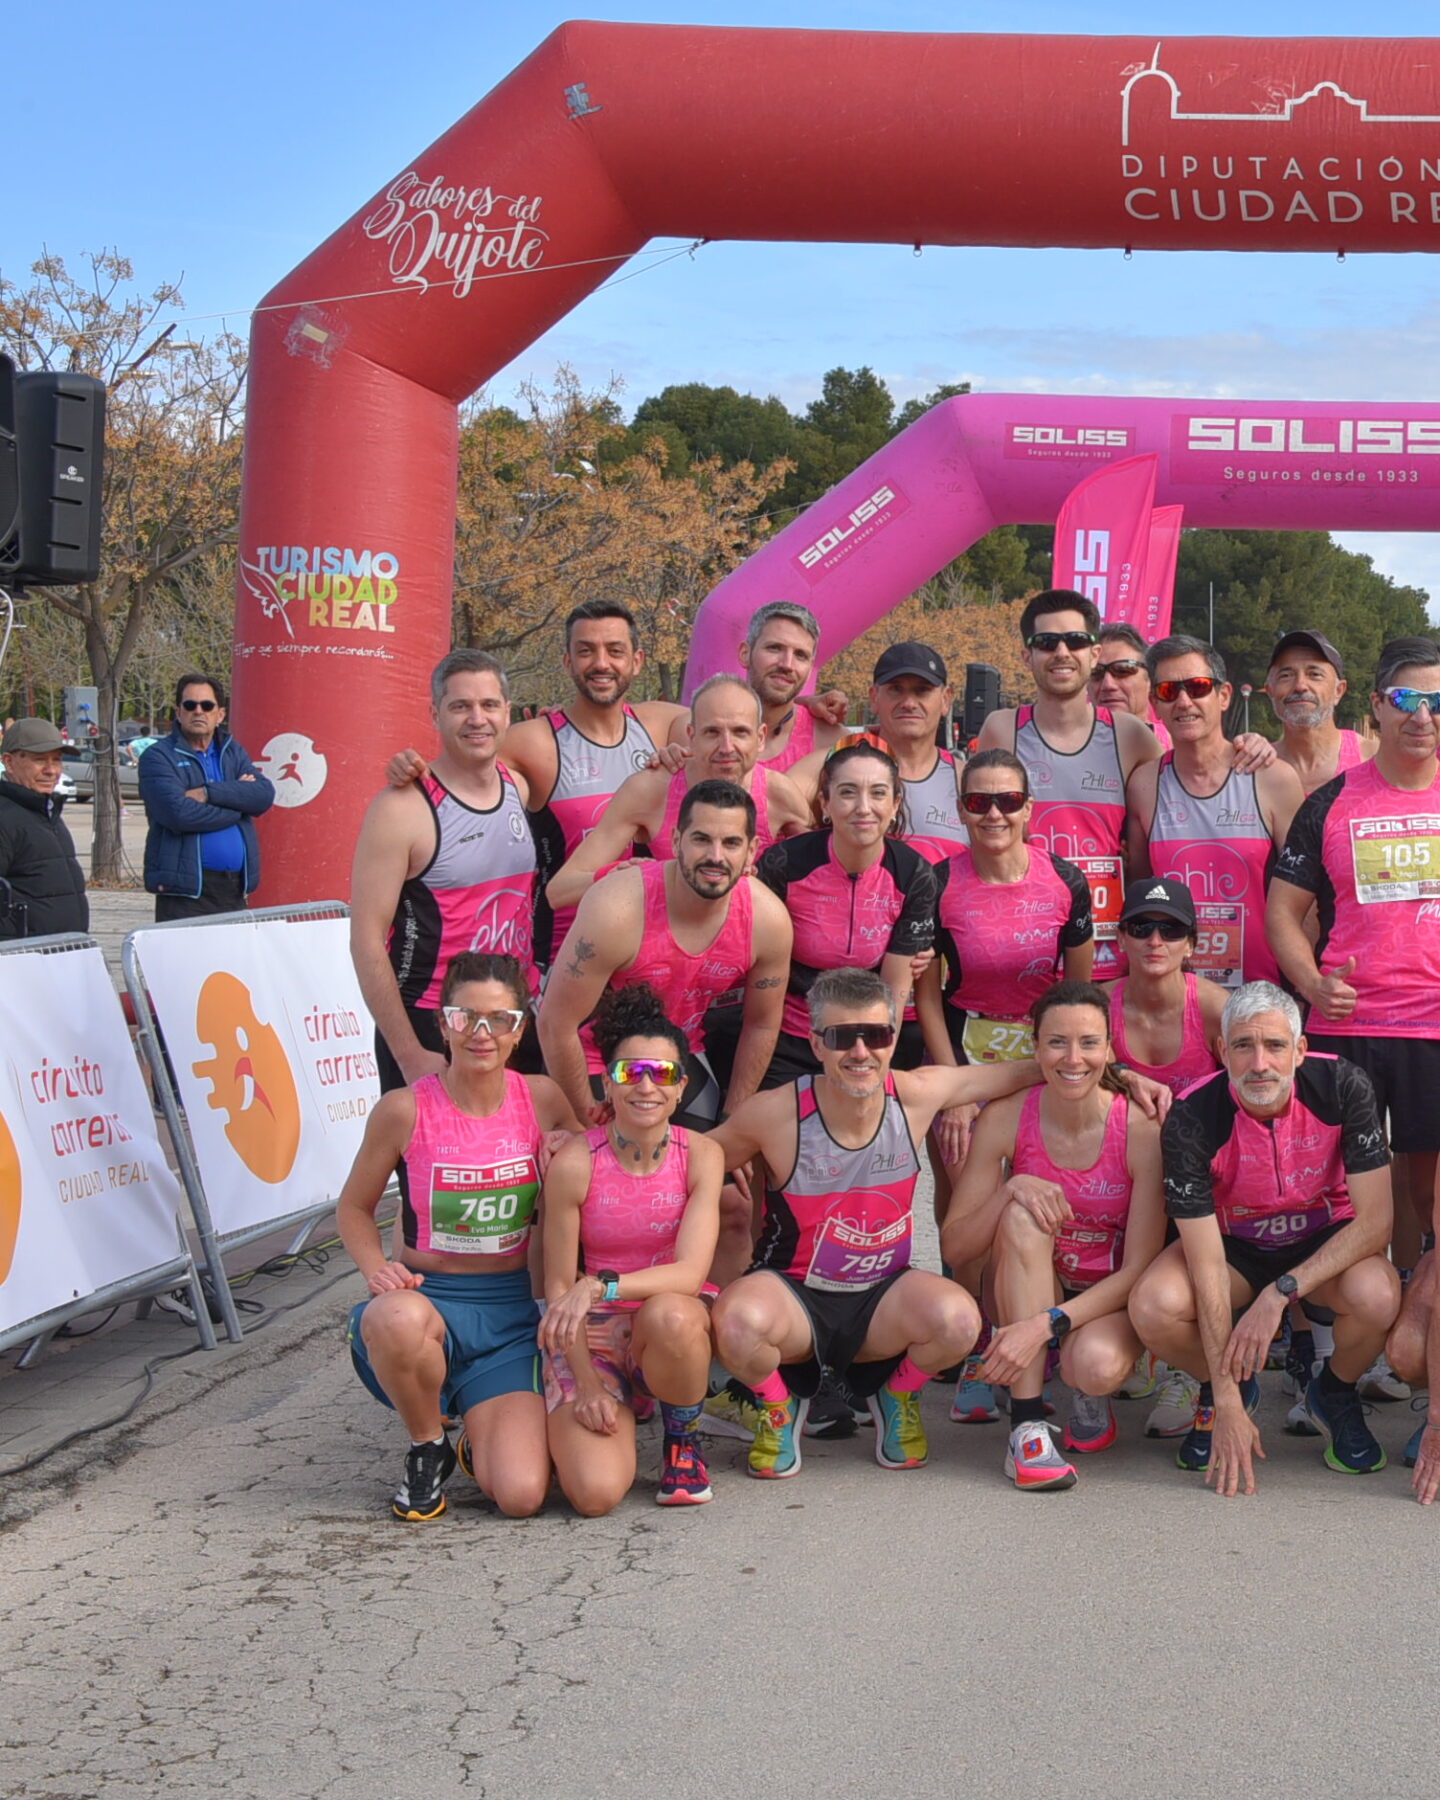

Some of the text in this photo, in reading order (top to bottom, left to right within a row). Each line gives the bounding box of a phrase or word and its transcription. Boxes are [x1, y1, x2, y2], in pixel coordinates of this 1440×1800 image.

[363, 171, 542, 240] Sabores del
[1124, 187, 1364, 223] CIUDAD
[388, 209, 549, 298] Quijote
[1012, 425, 1128, 448] SOLISS
[1027, 448, 1113, 460] Seguros desde 1933
[1223, 465, 1420, 484] Seguros desde 1933
[798, 485, 897, 569] SOLISS
[256, 545, 400, 580] TURISMO
[275, 571, 398, 606] CIUDAD
[308, 598, 396, 634] REAL
[1380, 842, 1431, 868] 105
[1193, 931, 1229, 955] 59
[494, 1138, 532, 1156] PHIGP
[58, 1160, 150, 1203] CIUDAD REAL
[441, 1161, 530, 1185] SOLISS
[1078, 1177, 1127, 1195] PHIGP
[458, 1193, 519, 1223] 760
[470, 1225, 486, 1234] Eva
[833, 1220, 908, 1249] SOLISS
[1253, 1213, 1308, 1239] 780
[839, 1248, 896, 1275] 795
